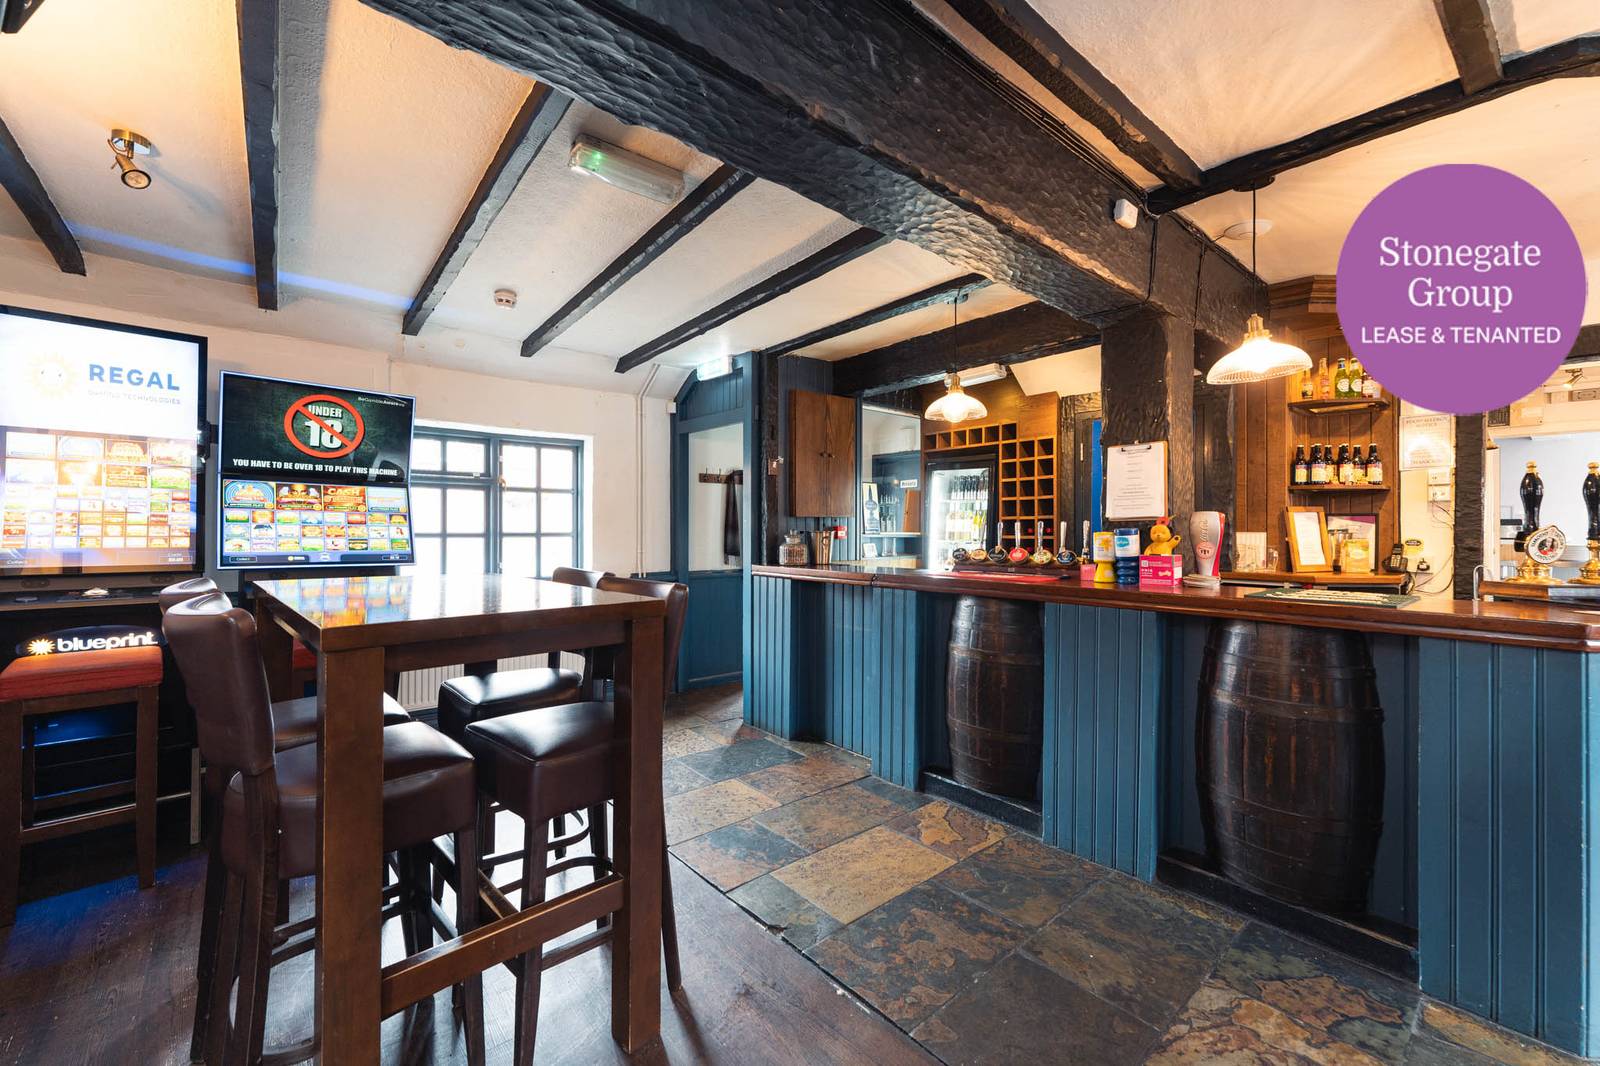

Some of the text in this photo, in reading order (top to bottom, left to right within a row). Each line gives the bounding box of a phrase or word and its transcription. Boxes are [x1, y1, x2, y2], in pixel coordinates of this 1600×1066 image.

[89, 363, 180, 391] REGAL
[308, 404, 342, 417] UNDER
[304, 419, 343, 449] 18
[233, 458, 249, 466] YOU
[251, 460, 271, 468] HAVE
[272, 461, 282, 469] TO
[283, 462, 293, 470] BE
[295, 463, 313, 471] OVER
[334, 465, 350, 473] PLAY
[352, 466, 368, 474] THIS
[369, 468, 398, 476] MACHINE
[57, 631, 158, 652] blueprint
